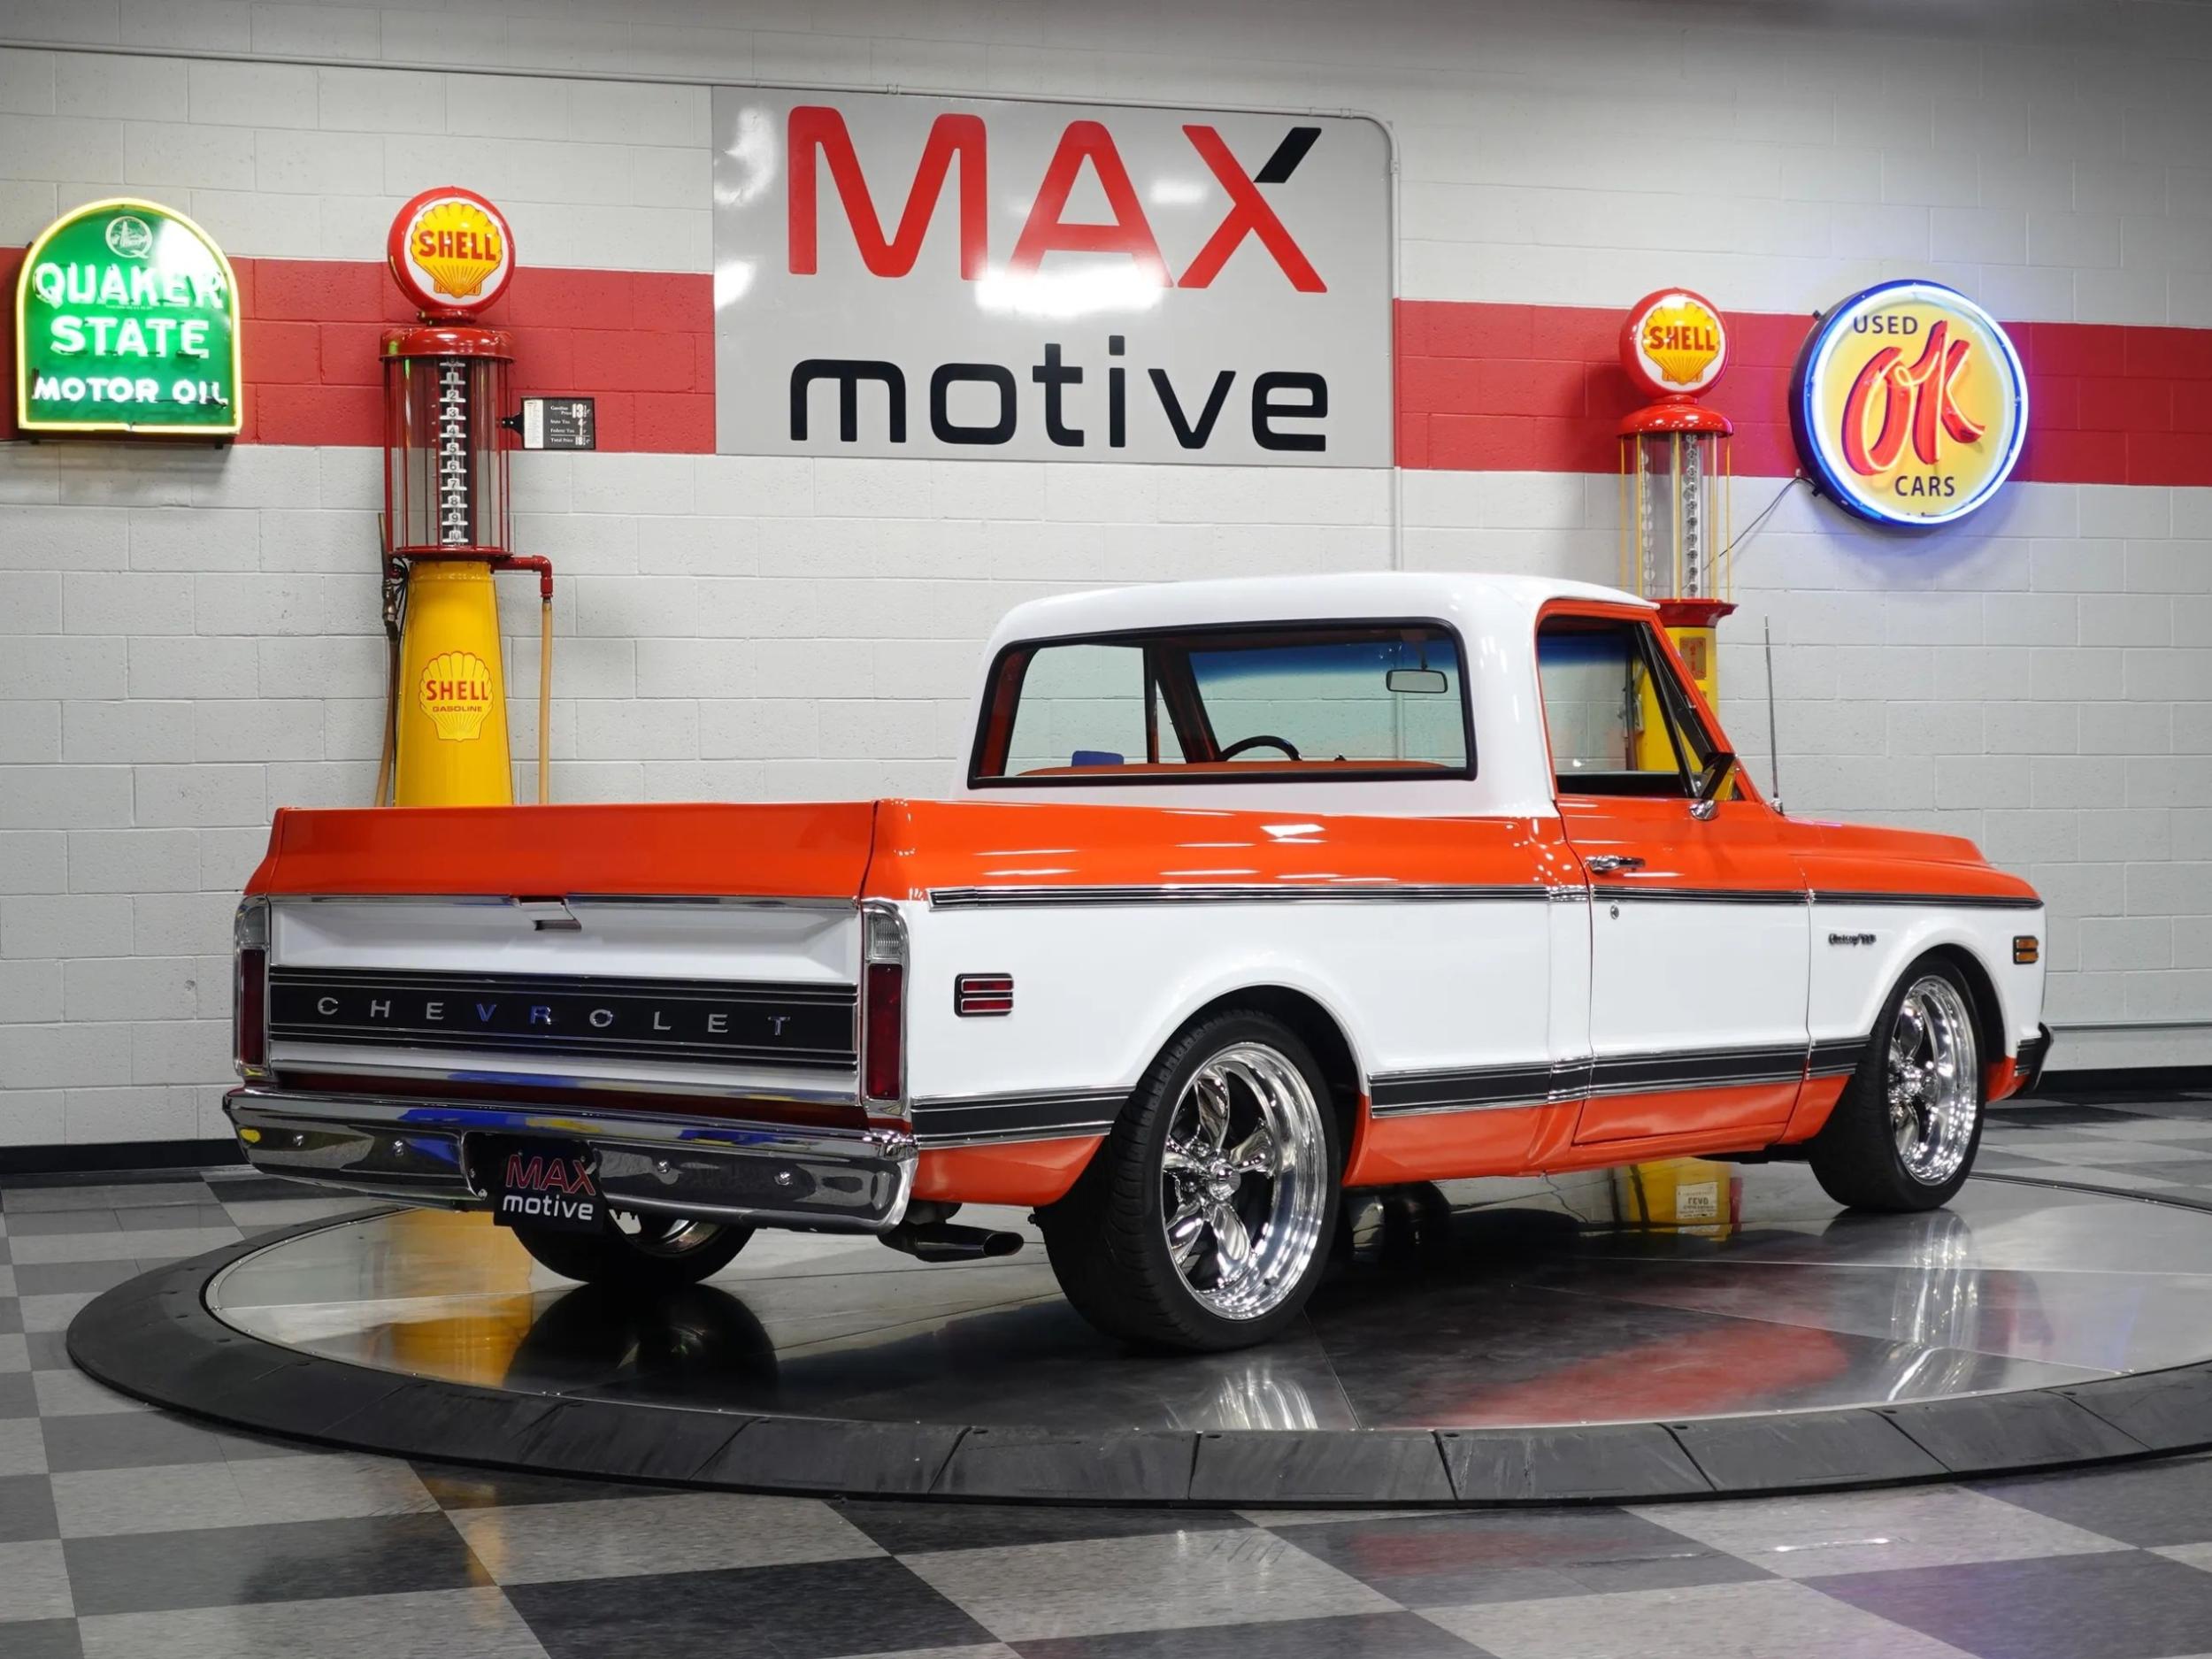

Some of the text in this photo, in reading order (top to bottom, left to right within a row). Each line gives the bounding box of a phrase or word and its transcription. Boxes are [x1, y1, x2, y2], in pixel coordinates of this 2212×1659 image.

[787, 105, 1328, 294] MAX
[419, 230, 497, 261] SHELL
[33, 262, 225, 309] QUAKER
[1853, 315, 1919, 335] USED
[50, 315, 211, 359] STATE
[1648, 326, 1717, 351] SHELL
[32, 376, 229, 406] MOTOR OIL
[449, 391, 457, 401] 2
[789, 334, 1328, 452] motive
[1840, 319, 1985, 477] OK
[449, 409, 457, 418] 3
[449, 426, 457, 435] 4
[449, 444, 457, 453] 5
[449, 461, 457, 471] 6
[450, 480, 457, 488] 7
[1894, 475, 1956, 497] CARS
[450, 496, 458, 506] 8
[451, 513, 458, 523] 9
[450, 531, 460, 541] 10
[426, 680, 488, 701] SHELL
[317, 996, 791, 1036] CHEVROLET
[505, 1154, 598, 1196] MAX
[503, 1194, 595, 1221] motive
